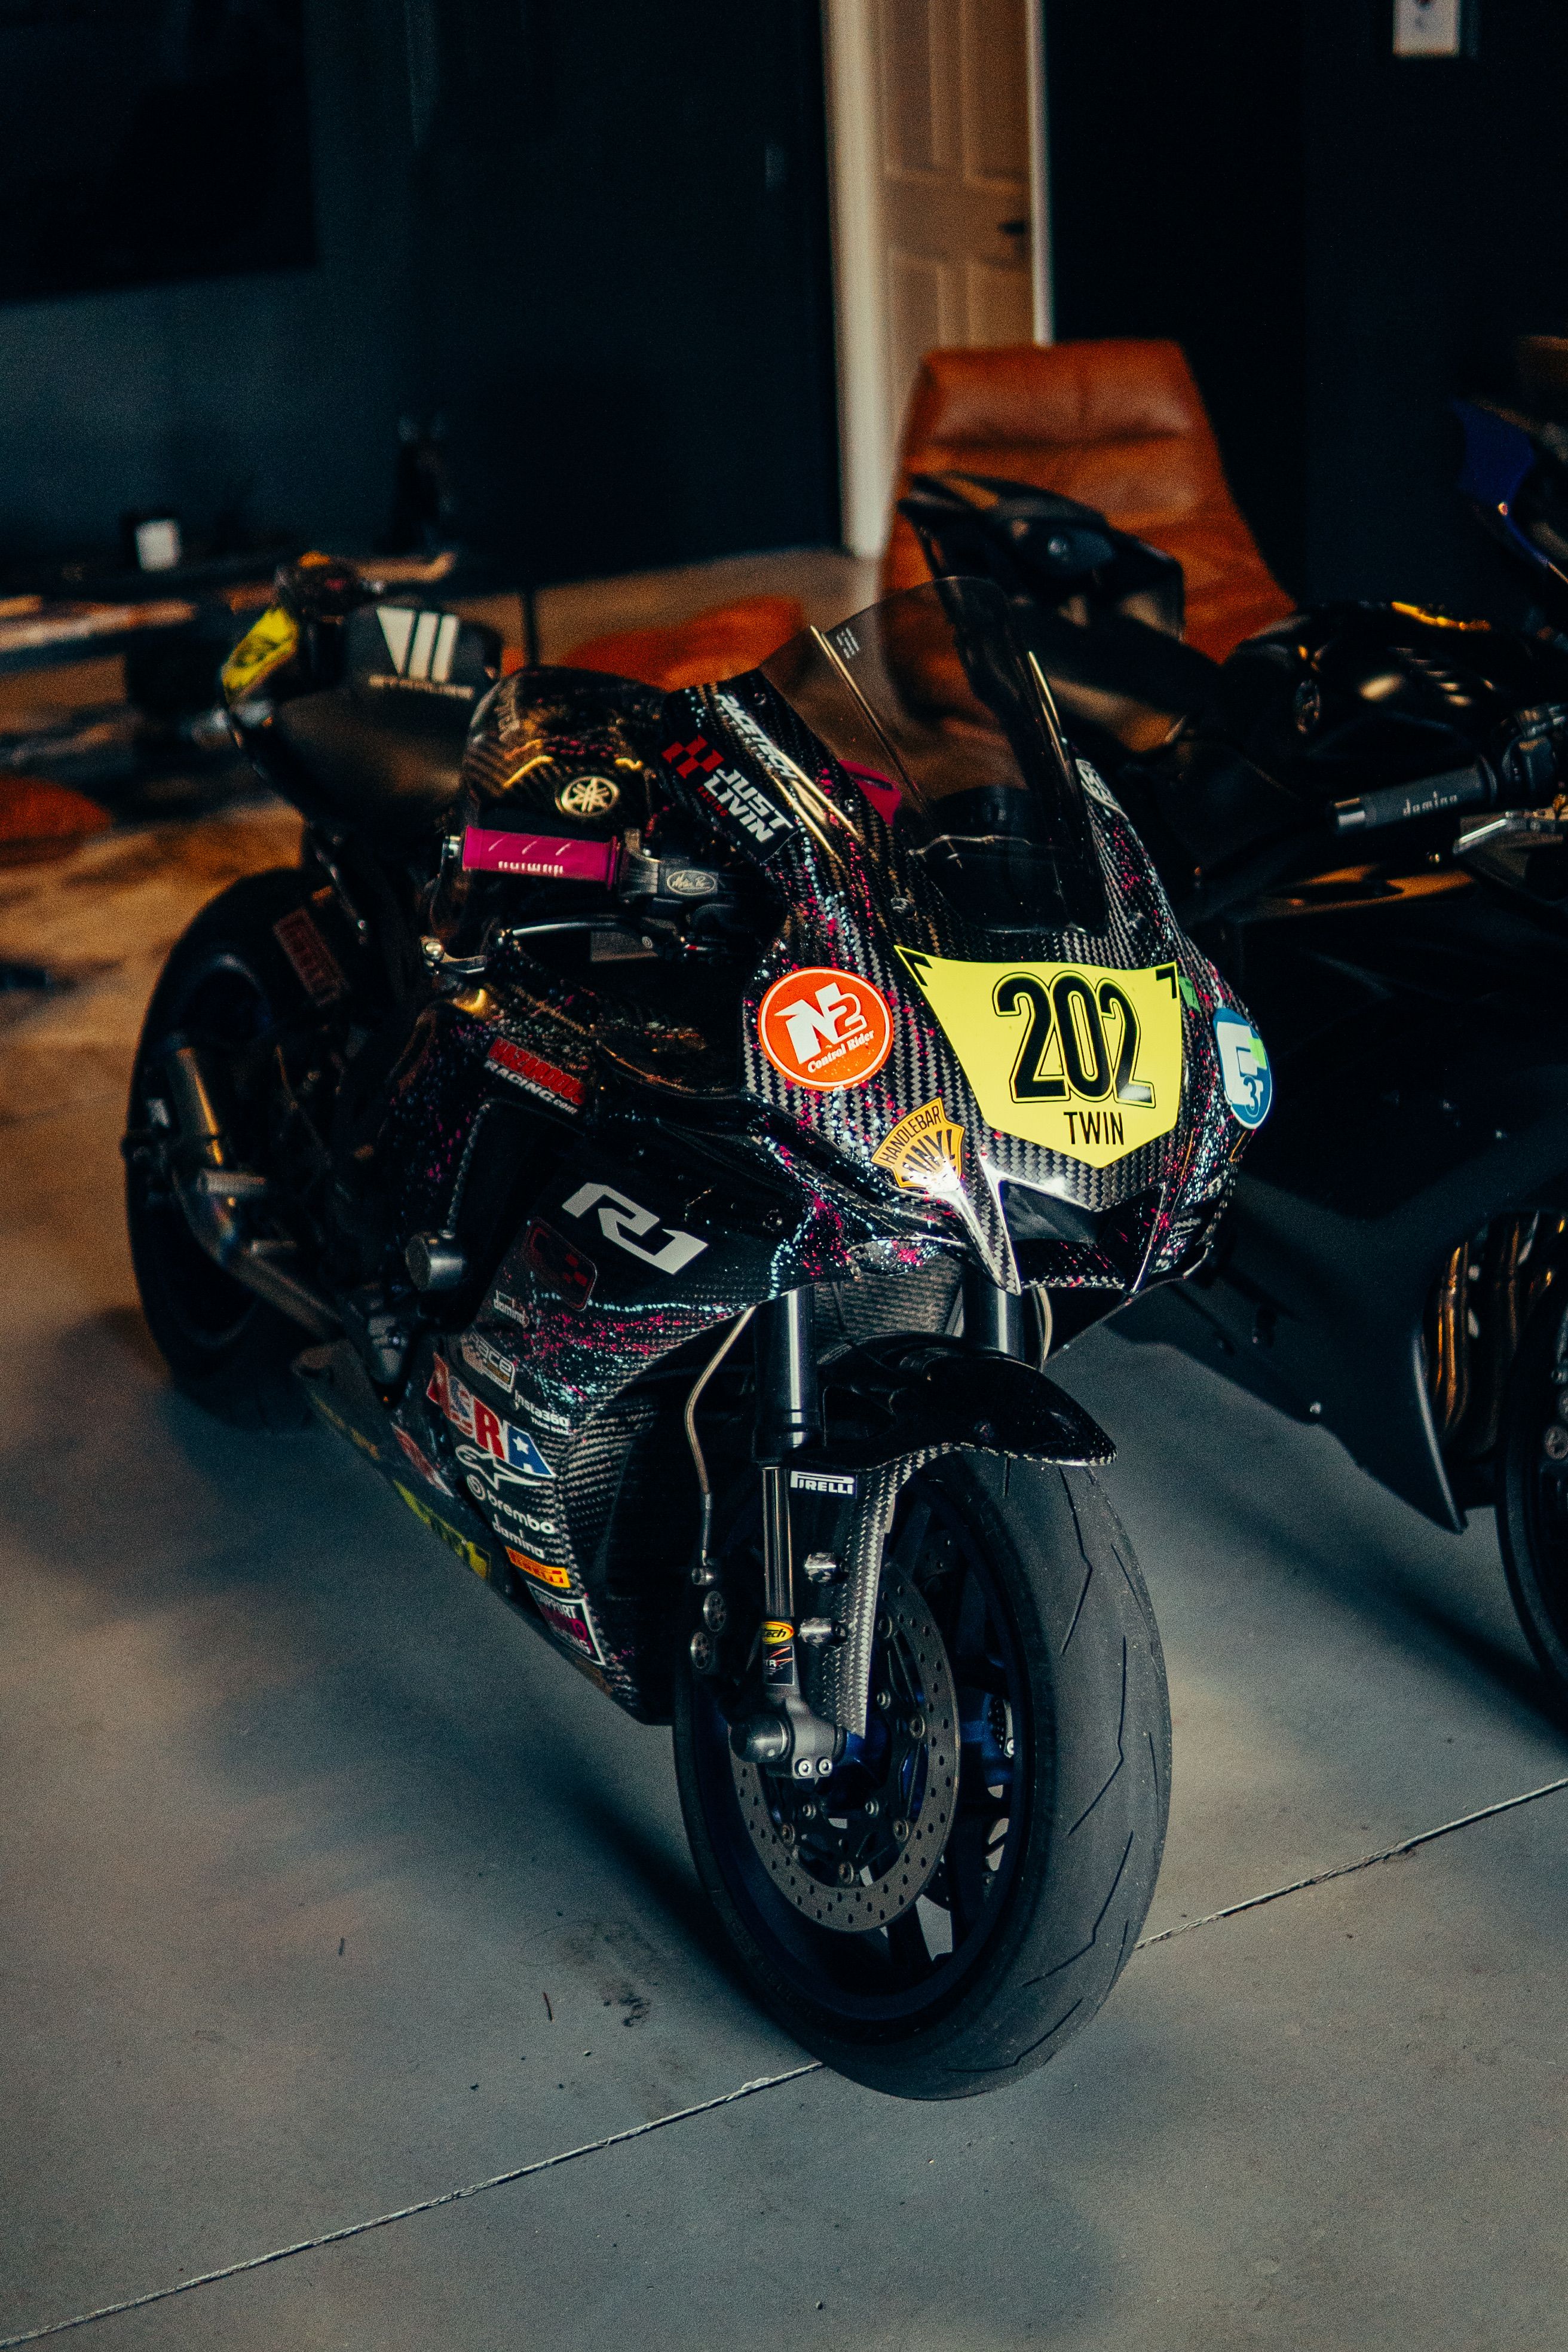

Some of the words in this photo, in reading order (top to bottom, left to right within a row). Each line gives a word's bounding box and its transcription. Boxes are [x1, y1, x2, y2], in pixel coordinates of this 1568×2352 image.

[715, 694, 798, 779] RACETECH
[696, 786, 728, 817] RACING
[703, 774, 774, 843] LIVIN
[716, 768, 794, 829] JUST
[774, 982, 868, 1065] N2
[807, 1043, 847, 1073] Control
[846, 1030, 875, 1052] Rider
[991, 970, 1156, 1109] 202
[879, 1105, 942, 1165] HANDLEBAR
[1063, 1111, 1124, 1146] TWIN
[561, 1182, 709, 1275] R1
[486, 1489, 556, 1535] brembo
[791, 1470, 855, 1494] PIRELLI
[492, 1513, 545, 1558] domino
